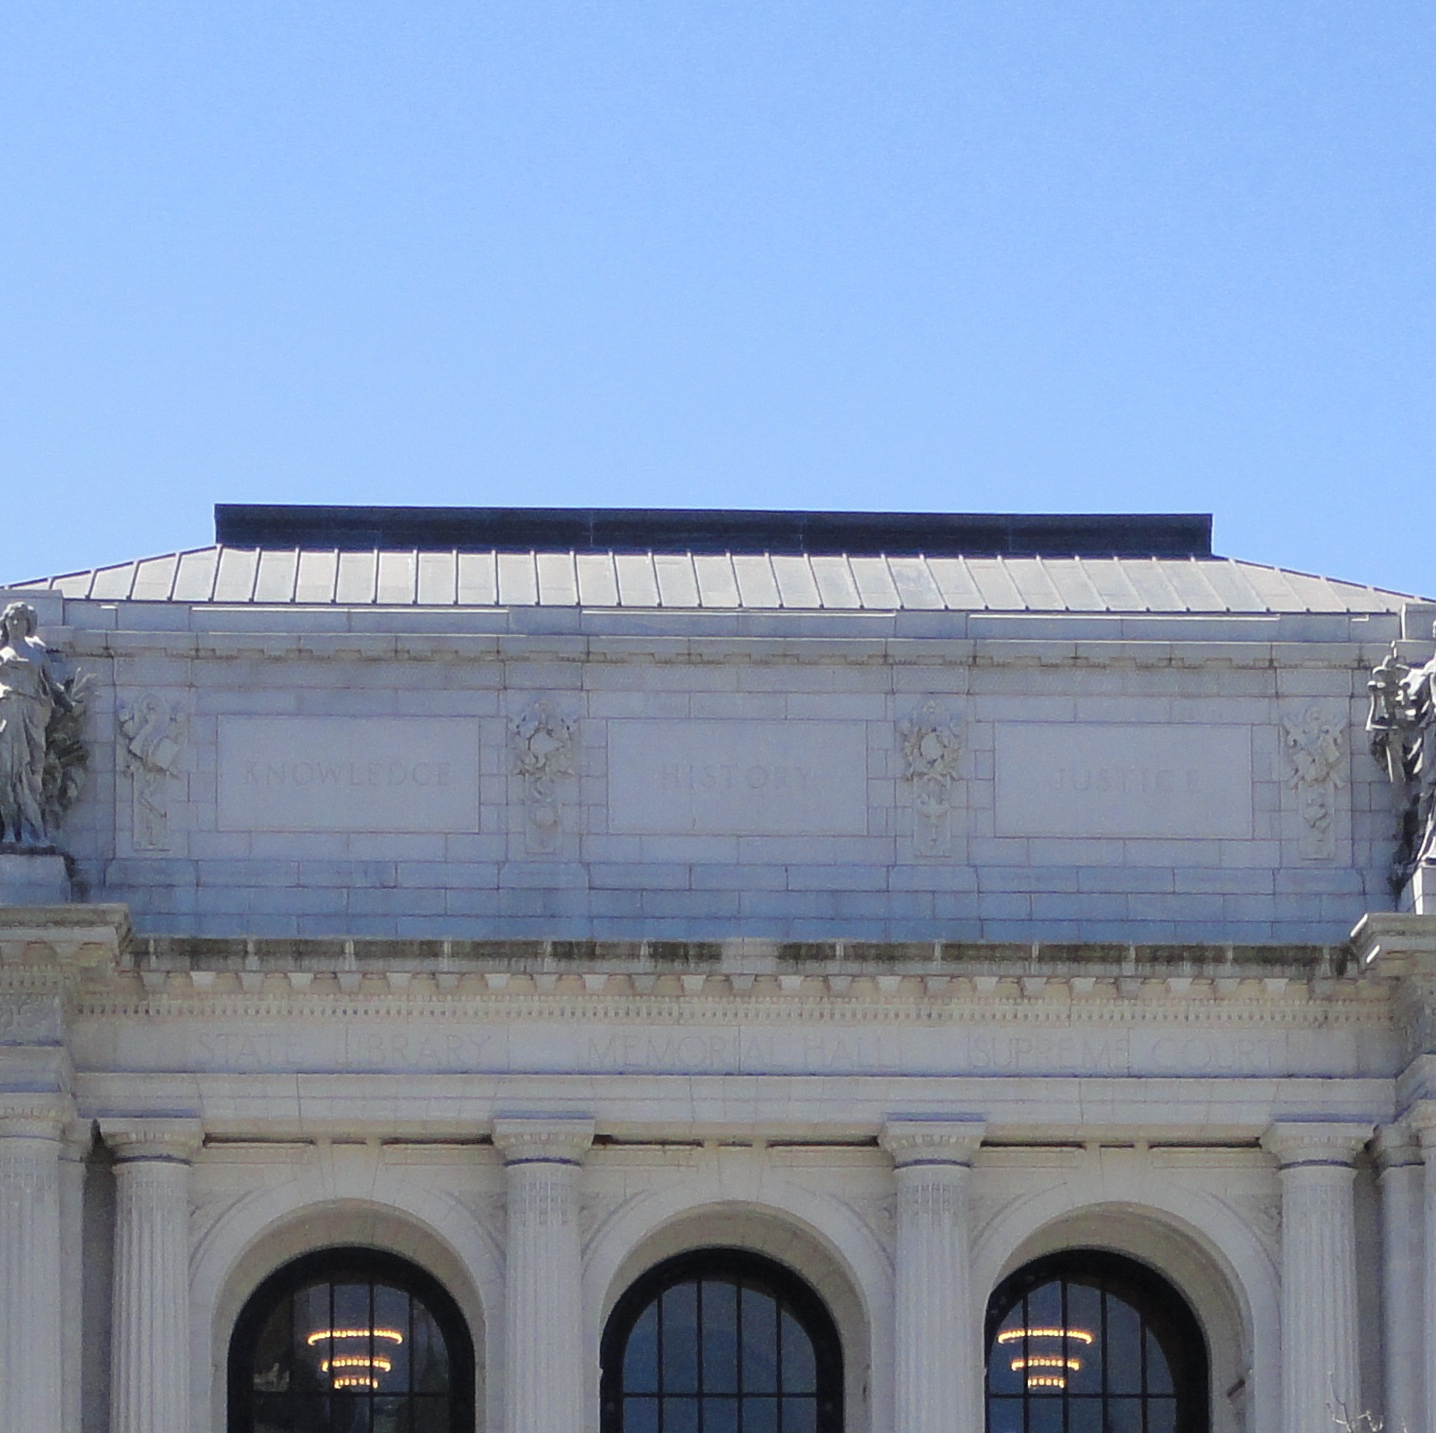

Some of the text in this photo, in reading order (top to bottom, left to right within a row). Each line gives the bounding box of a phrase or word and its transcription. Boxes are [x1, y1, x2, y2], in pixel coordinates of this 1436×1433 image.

[242, 760, 451, 787] KNOWLEDGE
[661, 763, 813, 790] HISTORY
[1050, 767, 1202, 794] JUSTICE
[195, 1032, 303, 1066] STATE
[586, 1034, 903, 1070] MEMORIAL HALL
[1150, 1037, 1281, 1071] COURT
